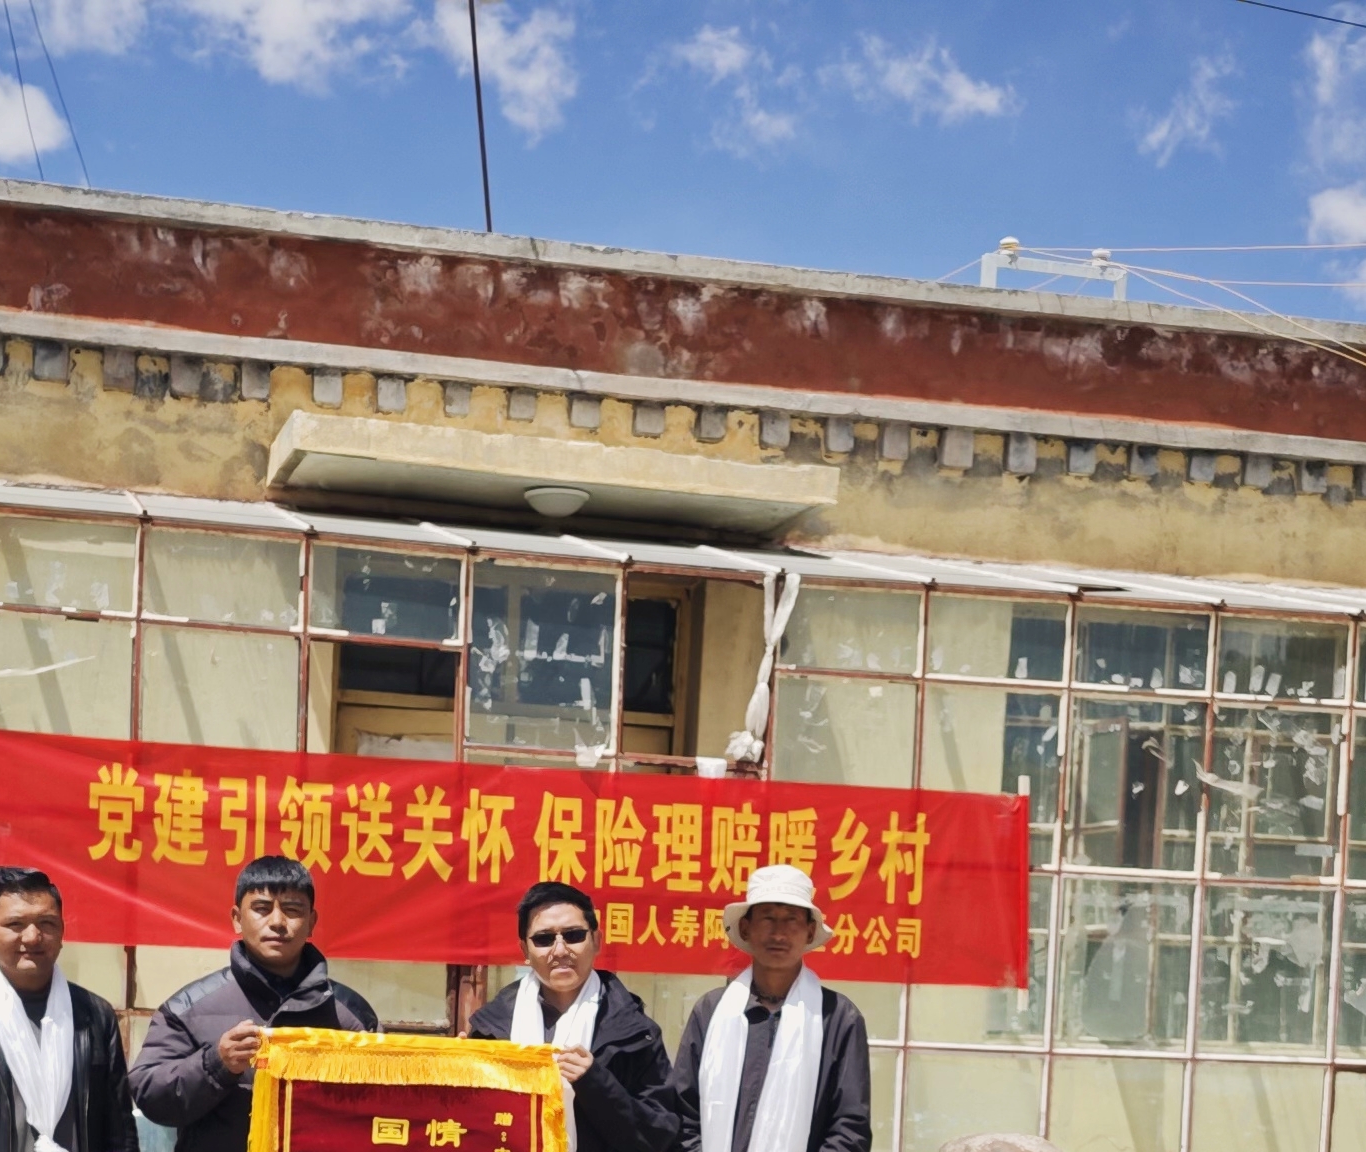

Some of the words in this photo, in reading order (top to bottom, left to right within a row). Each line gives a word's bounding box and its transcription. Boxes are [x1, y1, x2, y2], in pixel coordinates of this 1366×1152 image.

[88, 762, 515, 883] 党建引领送关怀
[533, 790, 931, 906] 保险理赔暖乡村
